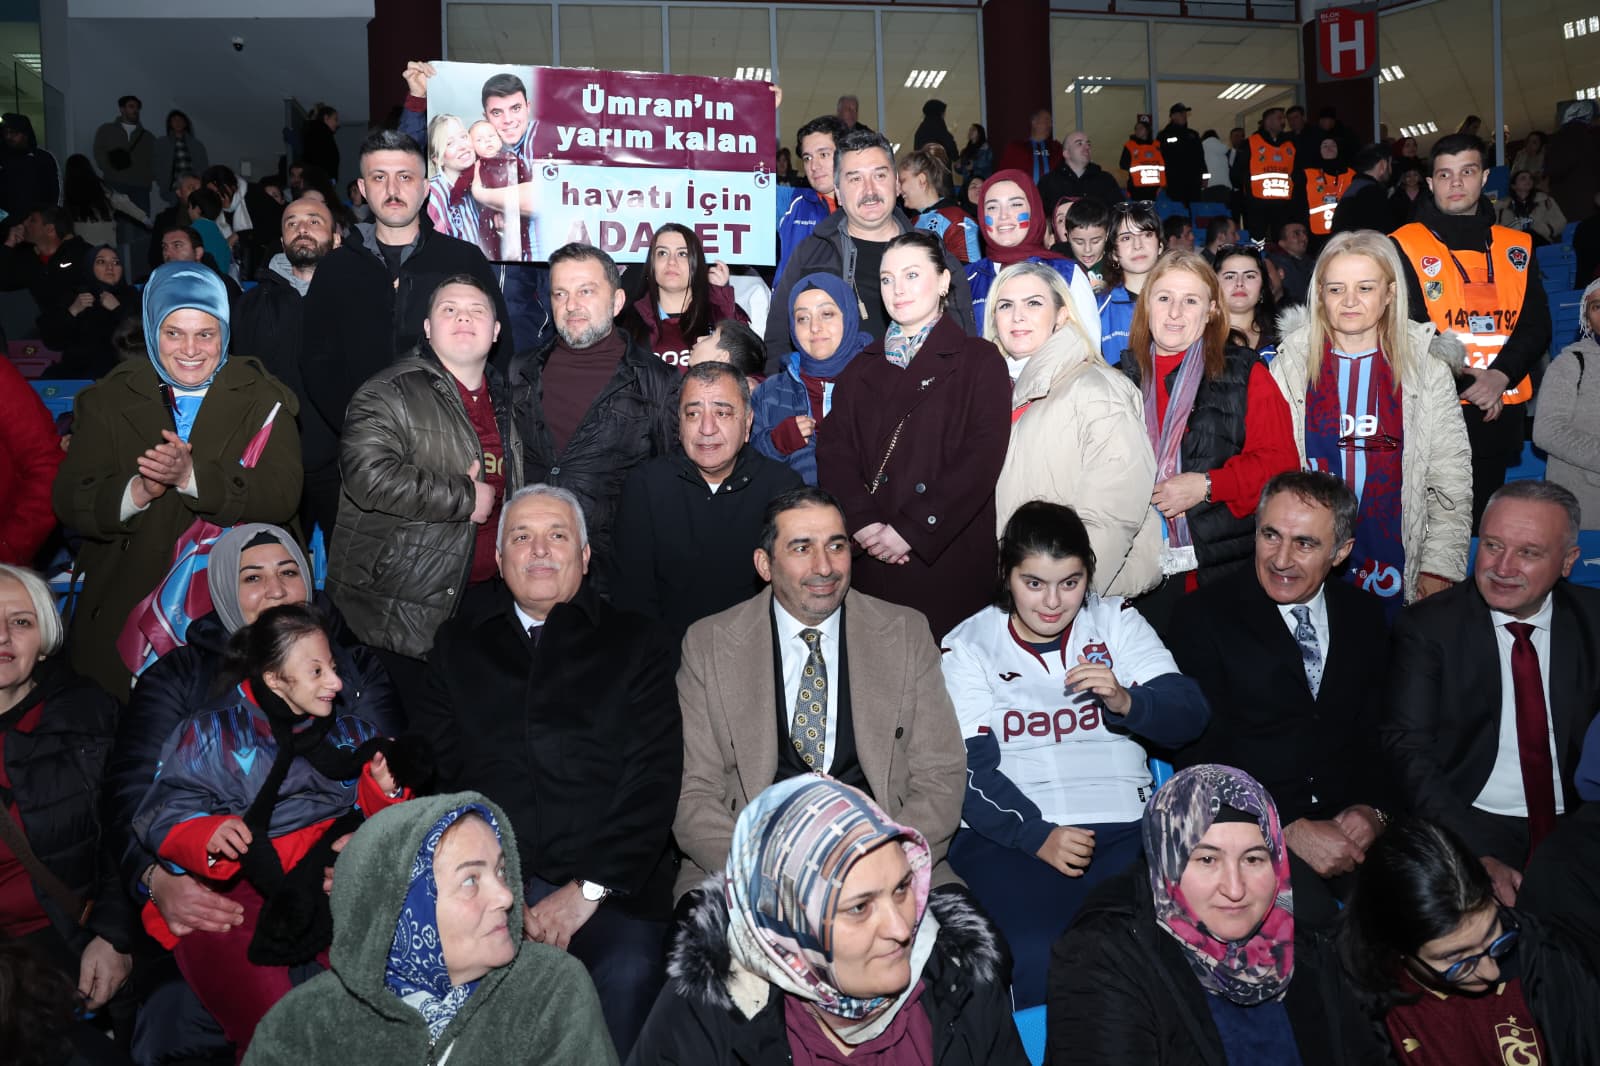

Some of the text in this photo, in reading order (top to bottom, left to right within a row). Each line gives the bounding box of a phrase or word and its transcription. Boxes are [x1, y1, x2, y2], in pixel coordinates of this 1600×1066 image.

[1330, 19, 1365, 74] H
[582, 83, 734, 121] Ümran'ın
[556, 125, 757, 153] yarım kalan
[562, 179, 751, 215] hayatı İçin
[566, 220, 752, 255] ADAET
[1003, 703, 1104, 743] papa
